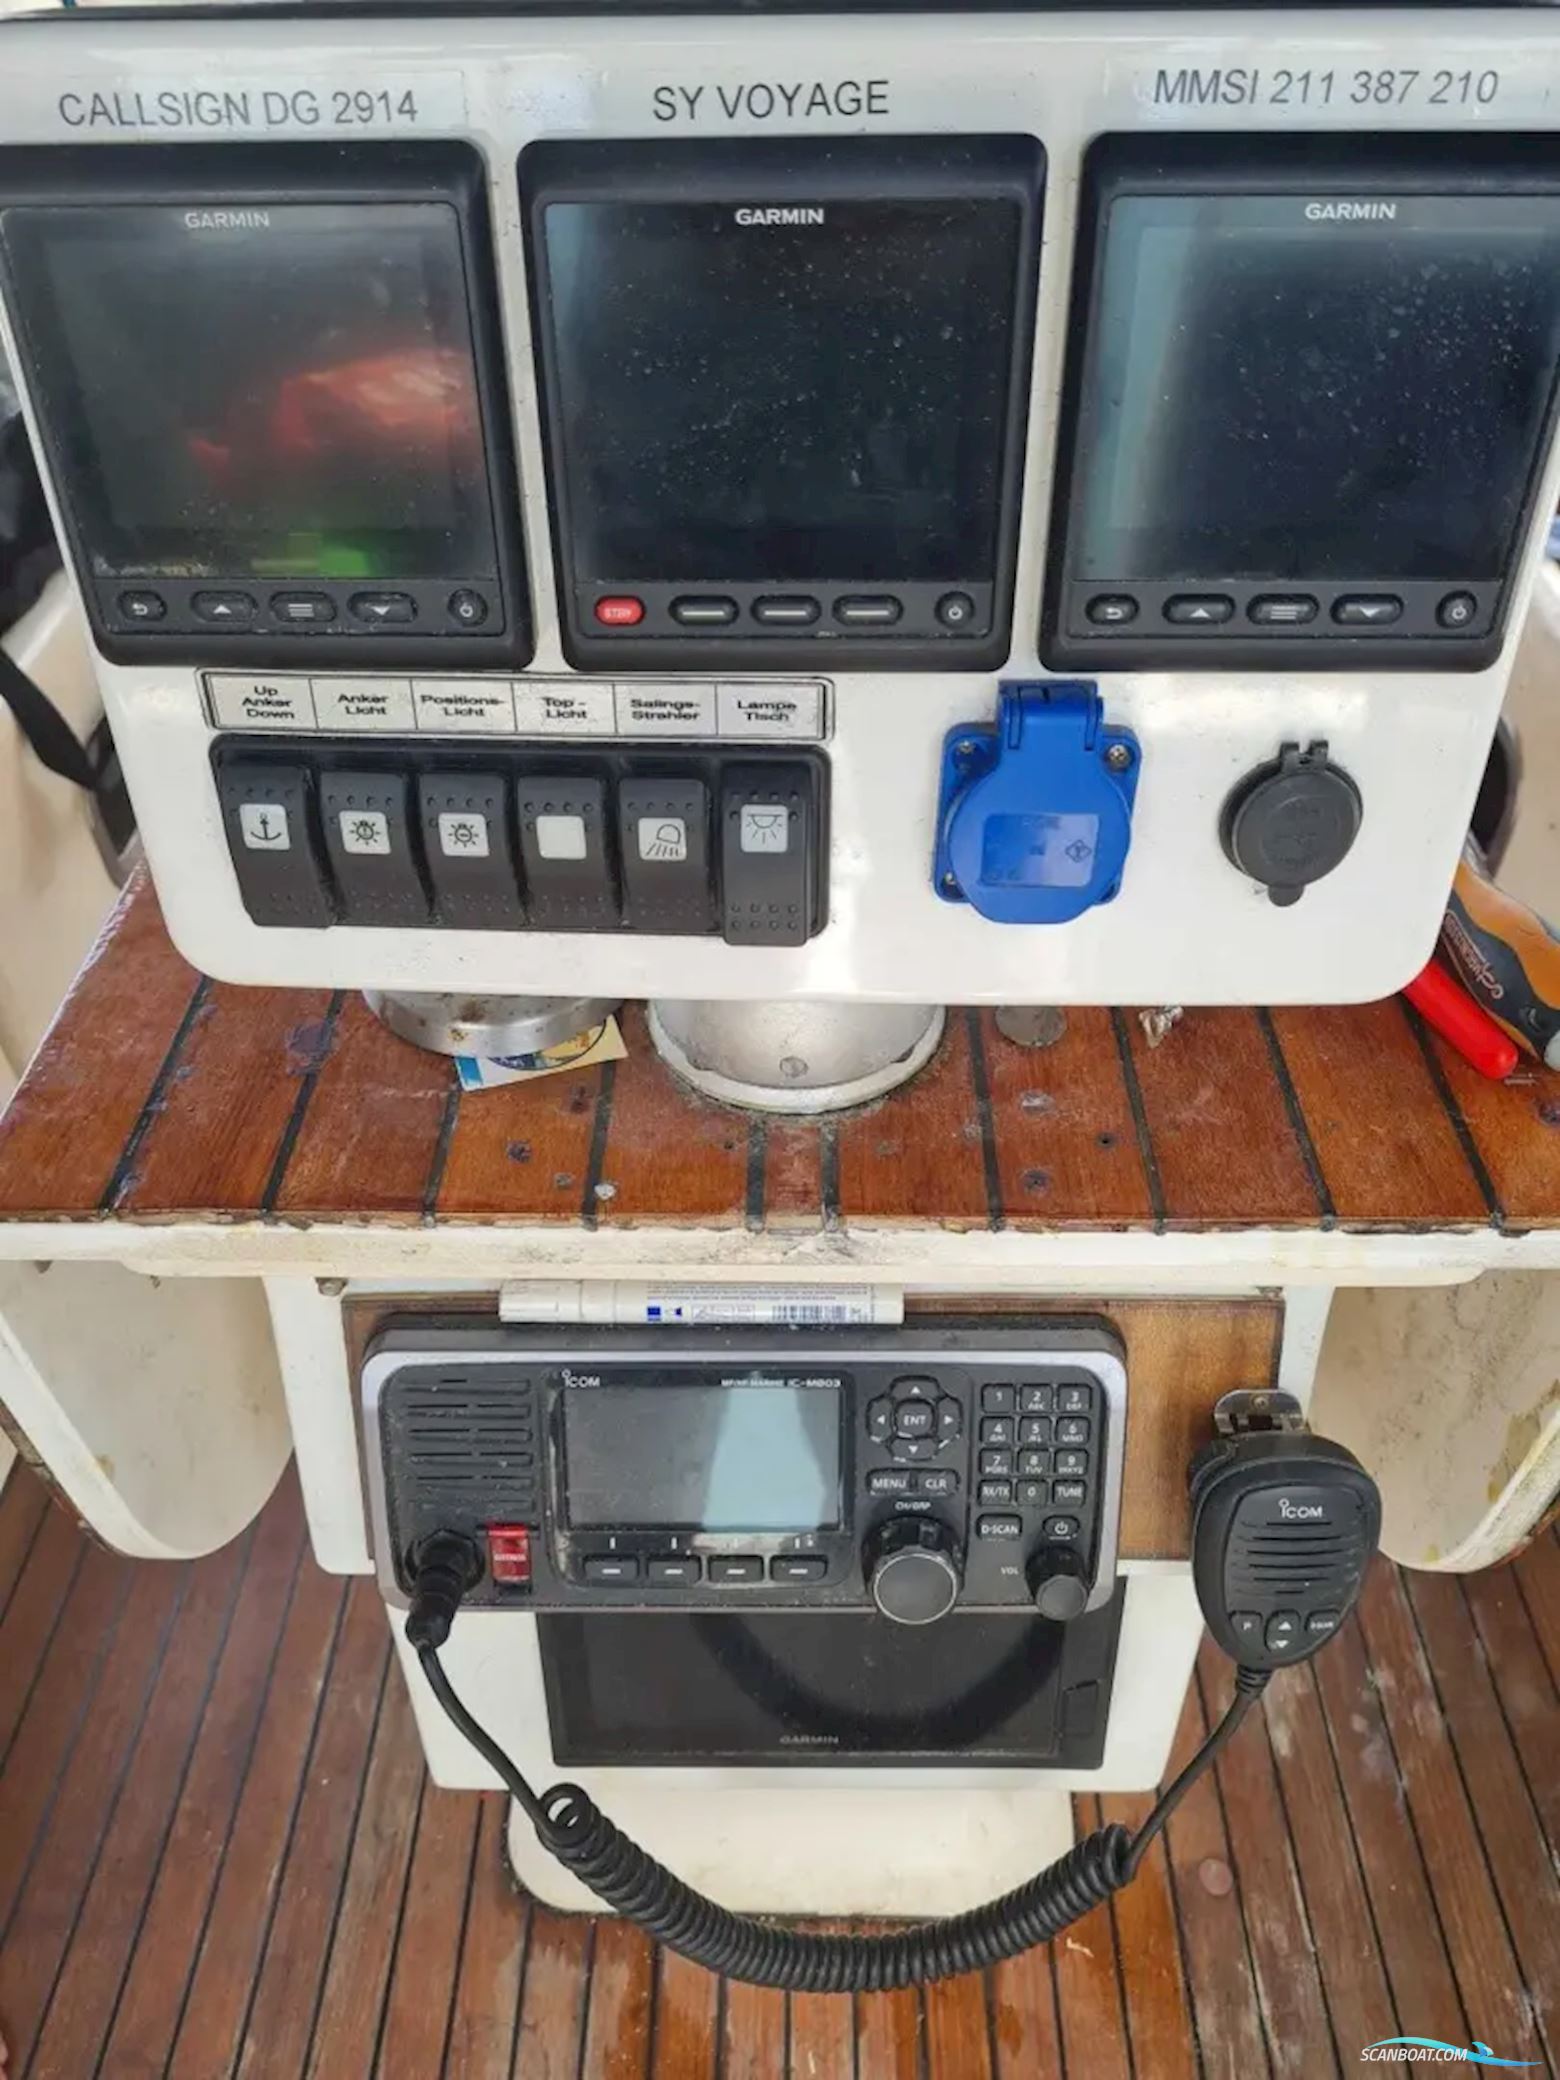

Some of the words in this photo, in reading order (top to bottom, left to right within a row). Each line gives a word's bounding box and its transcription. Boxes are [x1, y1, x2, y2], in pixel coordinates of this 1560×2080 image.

[1152, 68, 1258, 106] MMSI
[1270, 70, 1335, 105] 211
[1349, 70, 1419, 105] 387
[1427, 70, 1499, 104] 210
[652, 86, 700, 121] SY
[716, 80, 890, 119] VOYAGE
[58, 90, 251, 127] CALLSIGN
[266, 90, 319, 125] DG
[333, 89, 418, 124] 2914
[1304, 201, 1397, 220] GARMIN
[183, 210, 270, 229] GARMIN
[735, 208, 825, 227] GARMIN
[253, 685, 278, 697] Up
[241, 697, 292, 708] Anker
[337, 694, 389, 704] Anker
[542, 697, 575, 709] Top
[345, 704, 387, 715] Licht
[737, 699, 797, 711] Lampe
[246, 708, 295, 720] Down
[443, 706, 485, 717] Licht
[546, 708, 588, 719] Licht
[631, 710, 700, 721] Strahler
[744, 711, 789, 722] Tisch
[903, 1415, 926, 1426] ENT
[872, 1478, 907, 1489] MENU
[925, 1478, 947, 1489] CLR
[1056, 1486, 1083, 1498] TUNE
[1001, 1566, 1019, 1576] VOL
[779, 1735, 839, 1745] GARMIN
